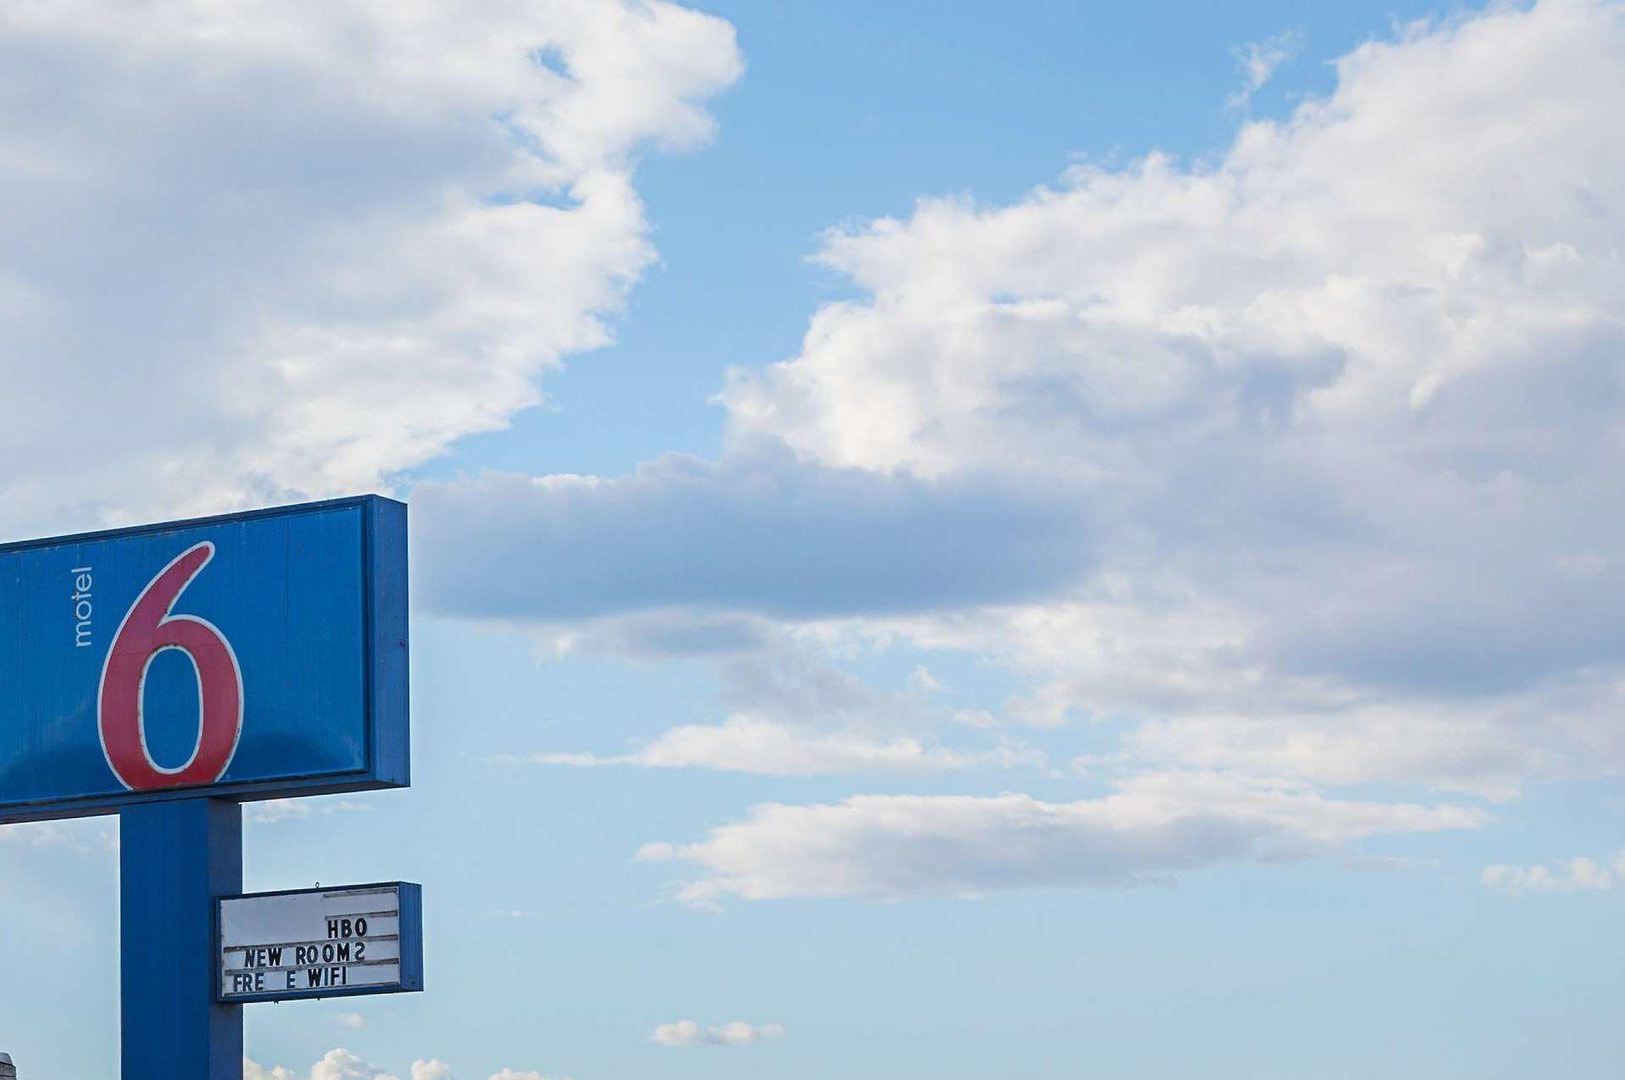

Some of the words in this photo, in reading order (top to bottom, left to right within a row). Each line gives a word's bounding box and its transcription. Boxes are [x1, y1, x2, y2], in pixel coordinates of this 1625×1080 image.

[71, 567, 92, 647] motel
[98, 541, 244, 791] 6
[327, 918, 367, 938] HBO
[244, 947, 282, 968] NEW
[233, 973, 264, 992] FRE
[307, 966, 347, 988] WIFI
